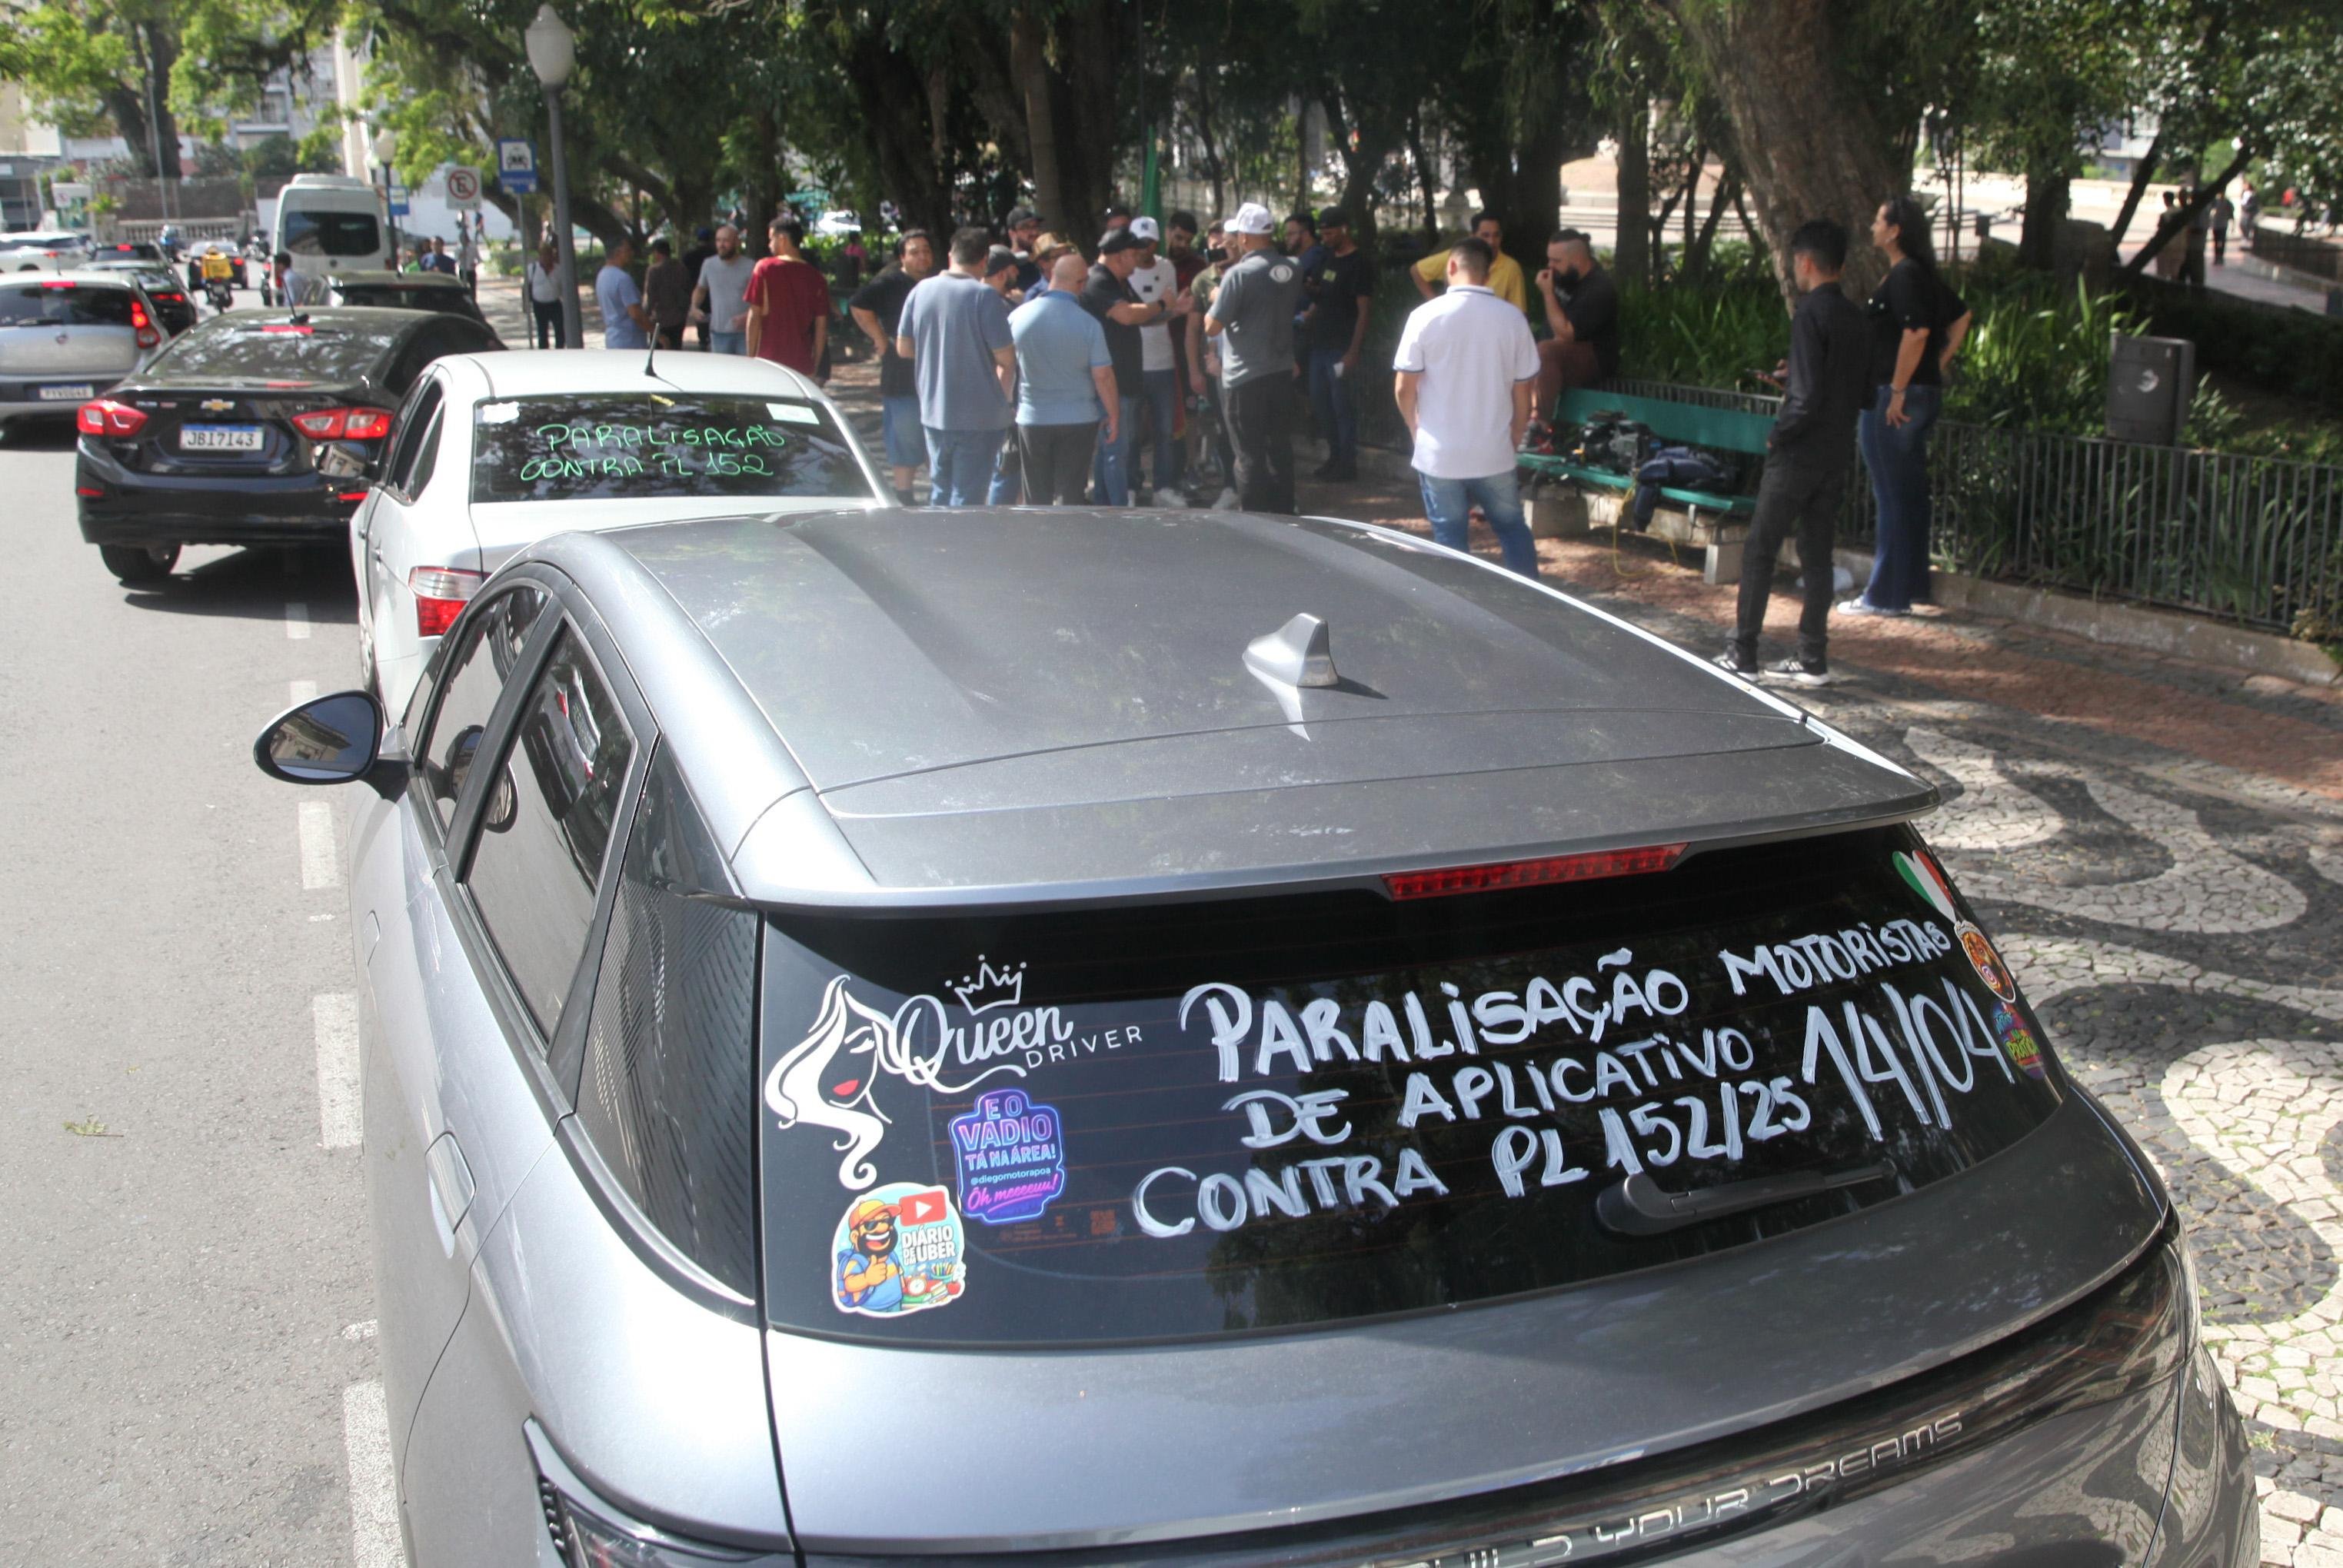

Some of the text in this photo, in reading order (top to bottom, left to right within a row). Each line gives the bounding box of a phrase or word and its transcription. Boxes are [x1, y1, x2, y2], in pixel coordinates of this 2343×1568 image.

[537, 424, 785, 451] PARALISAÇÃO
[521, 452, 774, 481] CONTRA PL 152
[1180, 918, 1952, 1083] PARALISAÇÃO MOTORISTAS
[894, 994, 1073, 1094] Queen
[1026, 1026, 1143, 1068] DRIVER
[1222, 977, 2015, 1148] DE APLICATIVO 14/04
[985, 1094, 1023, 1120] E O
[958, 1114, 1052, 1151] VADIO
[965, 1144, 1057, 1171] TÁ NA ÁREA!
[1133, 1077, 1812, 1237] CONTRA PL 152/25
[970, 1167, 1051, 1186] @diegomotorapoa
[901, 1224, 954, 1249] DIÁRIO
[903, 1247, 917, 1257] DE
[904, 1257, 917, 1267] UM
[916, 1240, 957, 1262] UBER
[1595, 1488, 1748, 1545] YOUR
[1769, 1411, 1963, 1502] DREAMS
